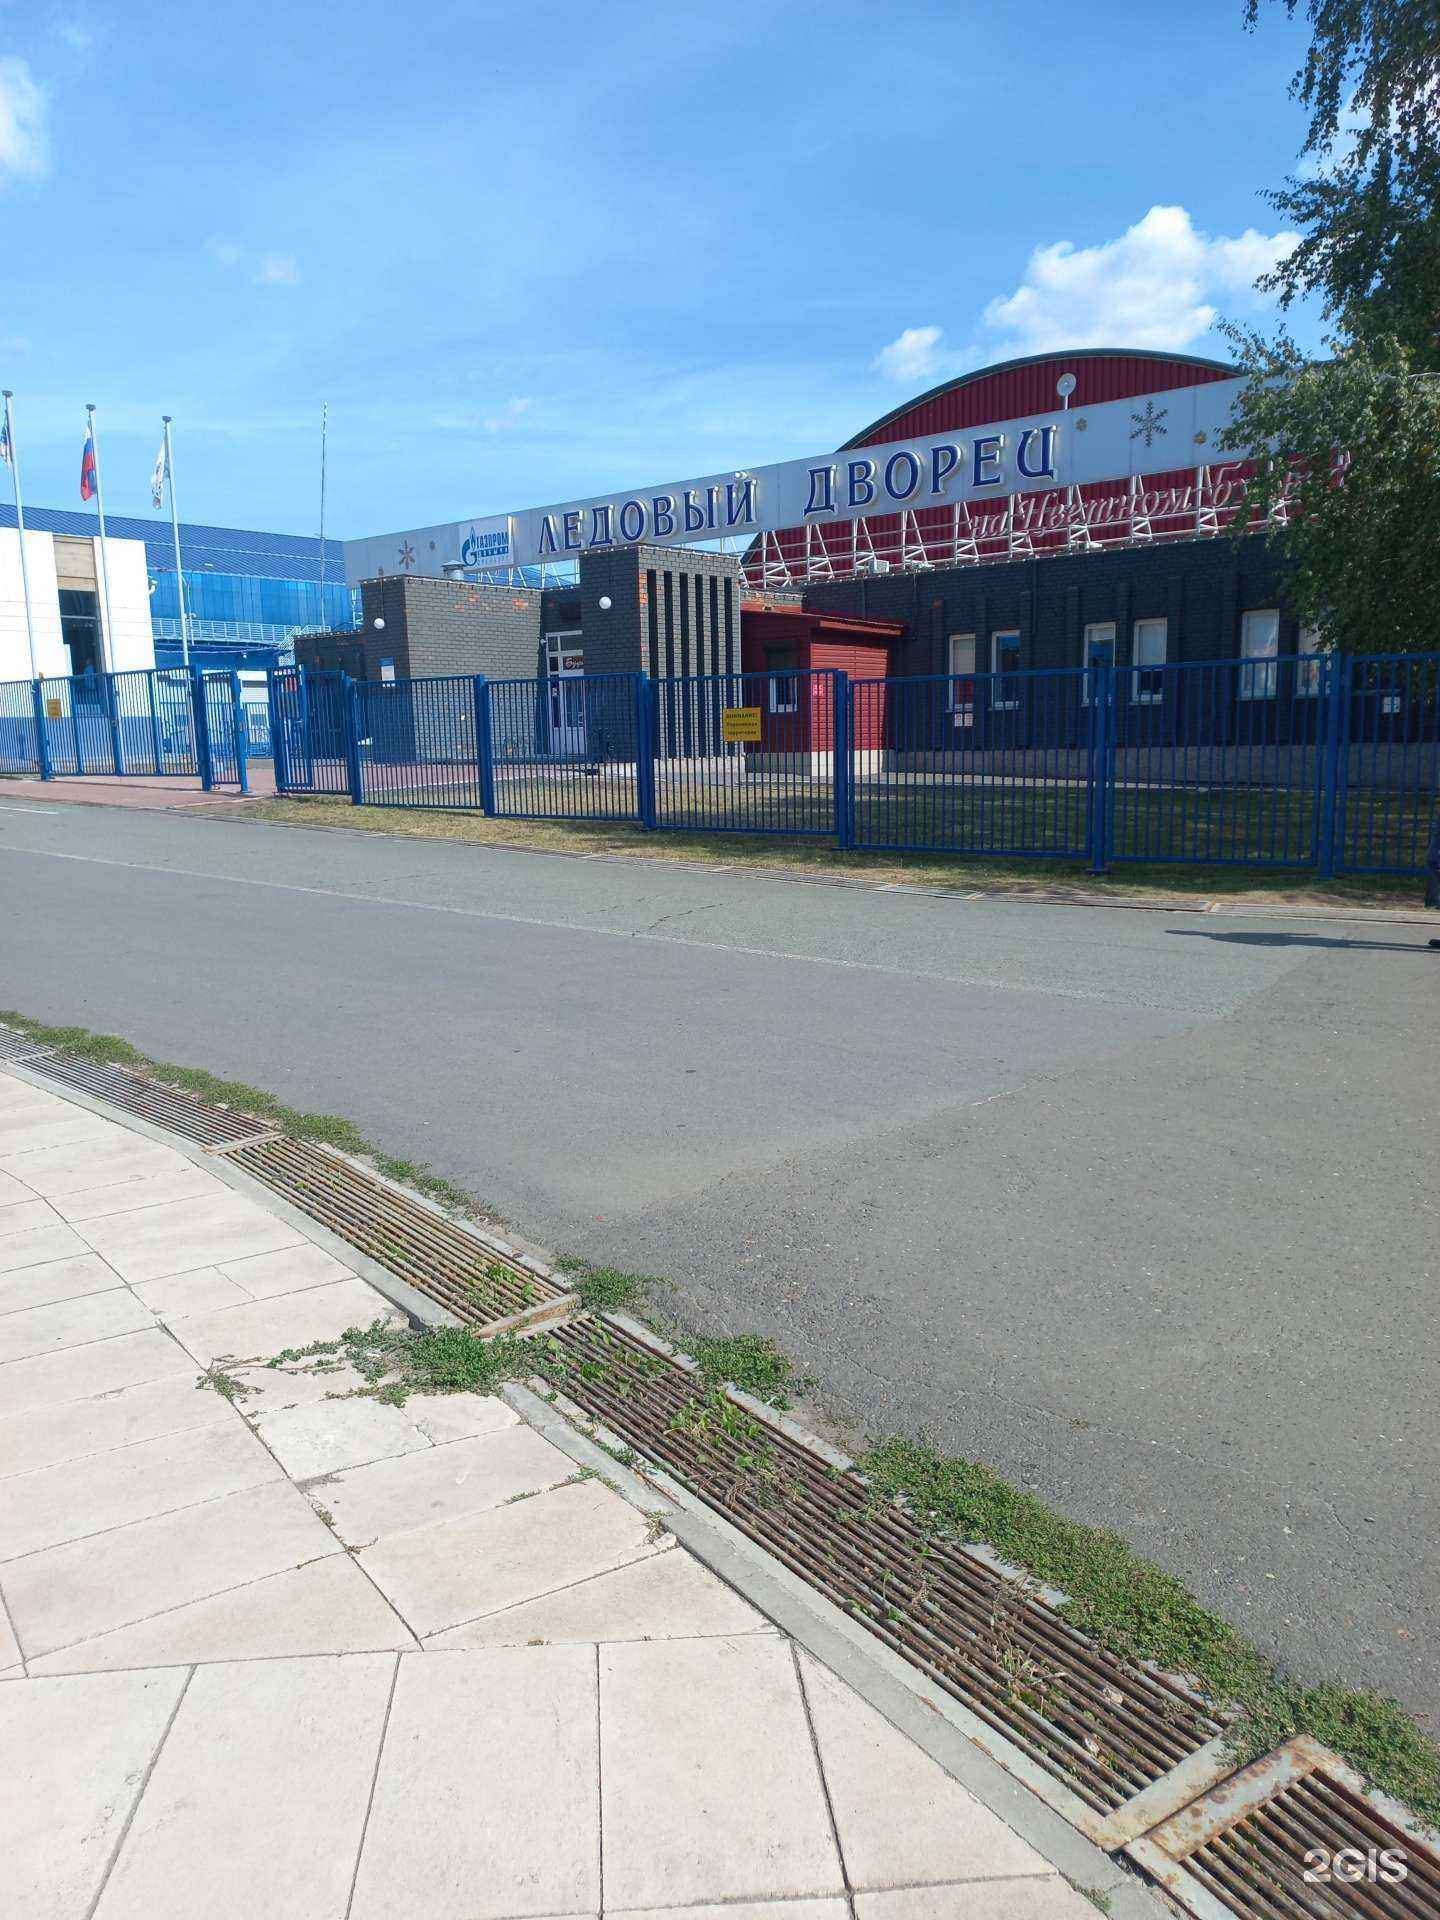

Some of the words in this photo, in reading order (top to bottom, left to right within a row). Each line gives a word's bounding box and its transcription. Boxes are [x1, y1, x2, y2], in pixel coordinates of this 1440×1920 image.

[539, 472, 758, 553] ЛЕДОВЫЙ
[803, 425, 1057, 517] ДВОРЕЦ
[476, 531, 508, 549] ГАЗПРОМ
